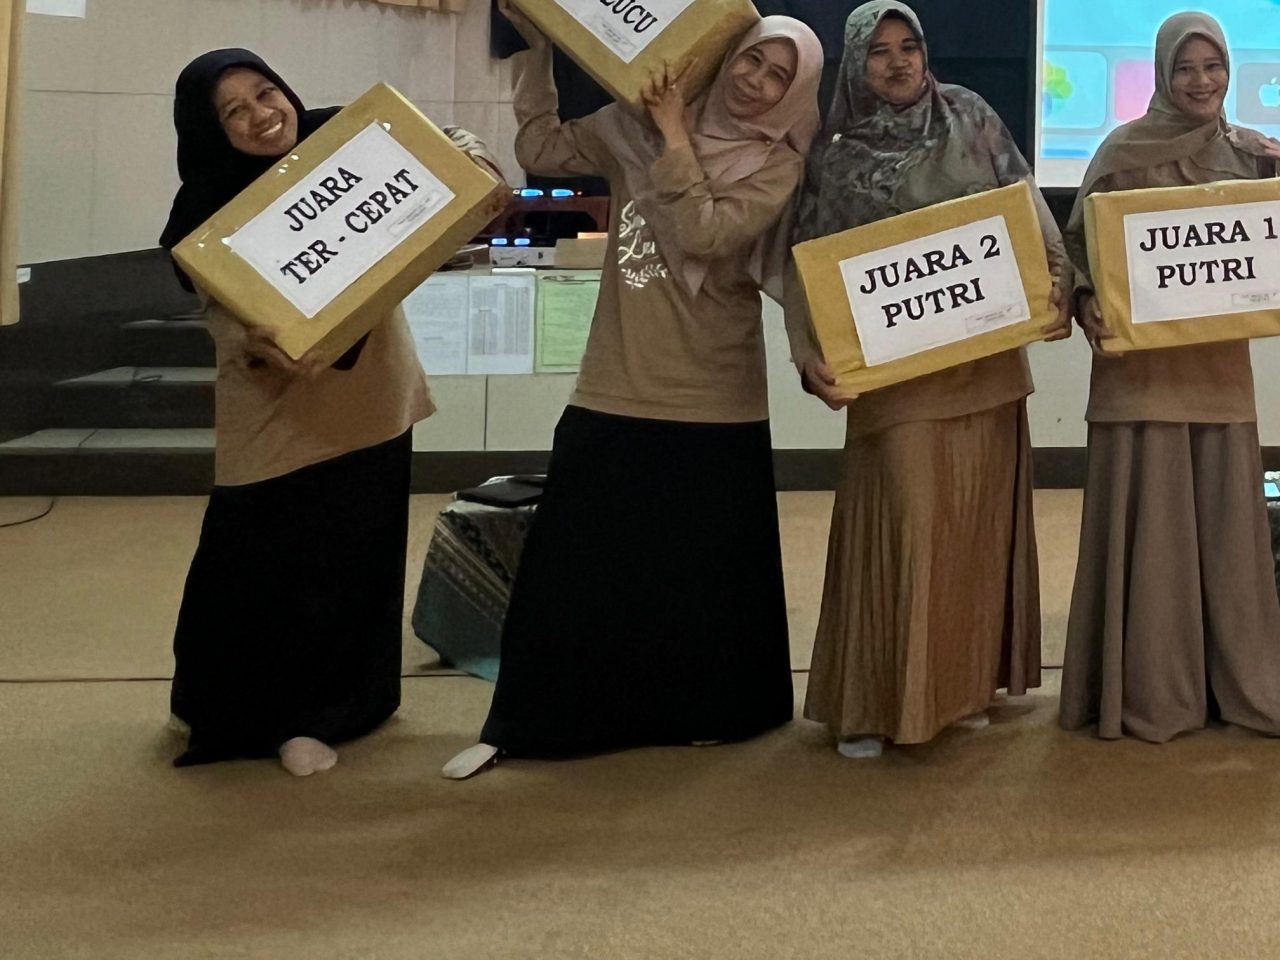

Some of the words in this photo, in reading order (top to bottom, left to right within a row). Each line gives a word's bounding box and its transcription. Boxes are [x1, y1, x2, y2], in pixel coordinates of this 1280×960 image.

[279, 239, 339, 285] TER
[344, 168, 419, 234] CEPAT
[283, 167, 363, 232] JUARA
[1139, 219, 1251, 252] JUARA
[1263, 216, 1278, 240] 1
[860, 244, 973, 295] JUARA
[979, 234, 1001, 260] 2
[1156, 256, 1257, 289] PUTRI
[881, 277, 986, 329] PUTRI
